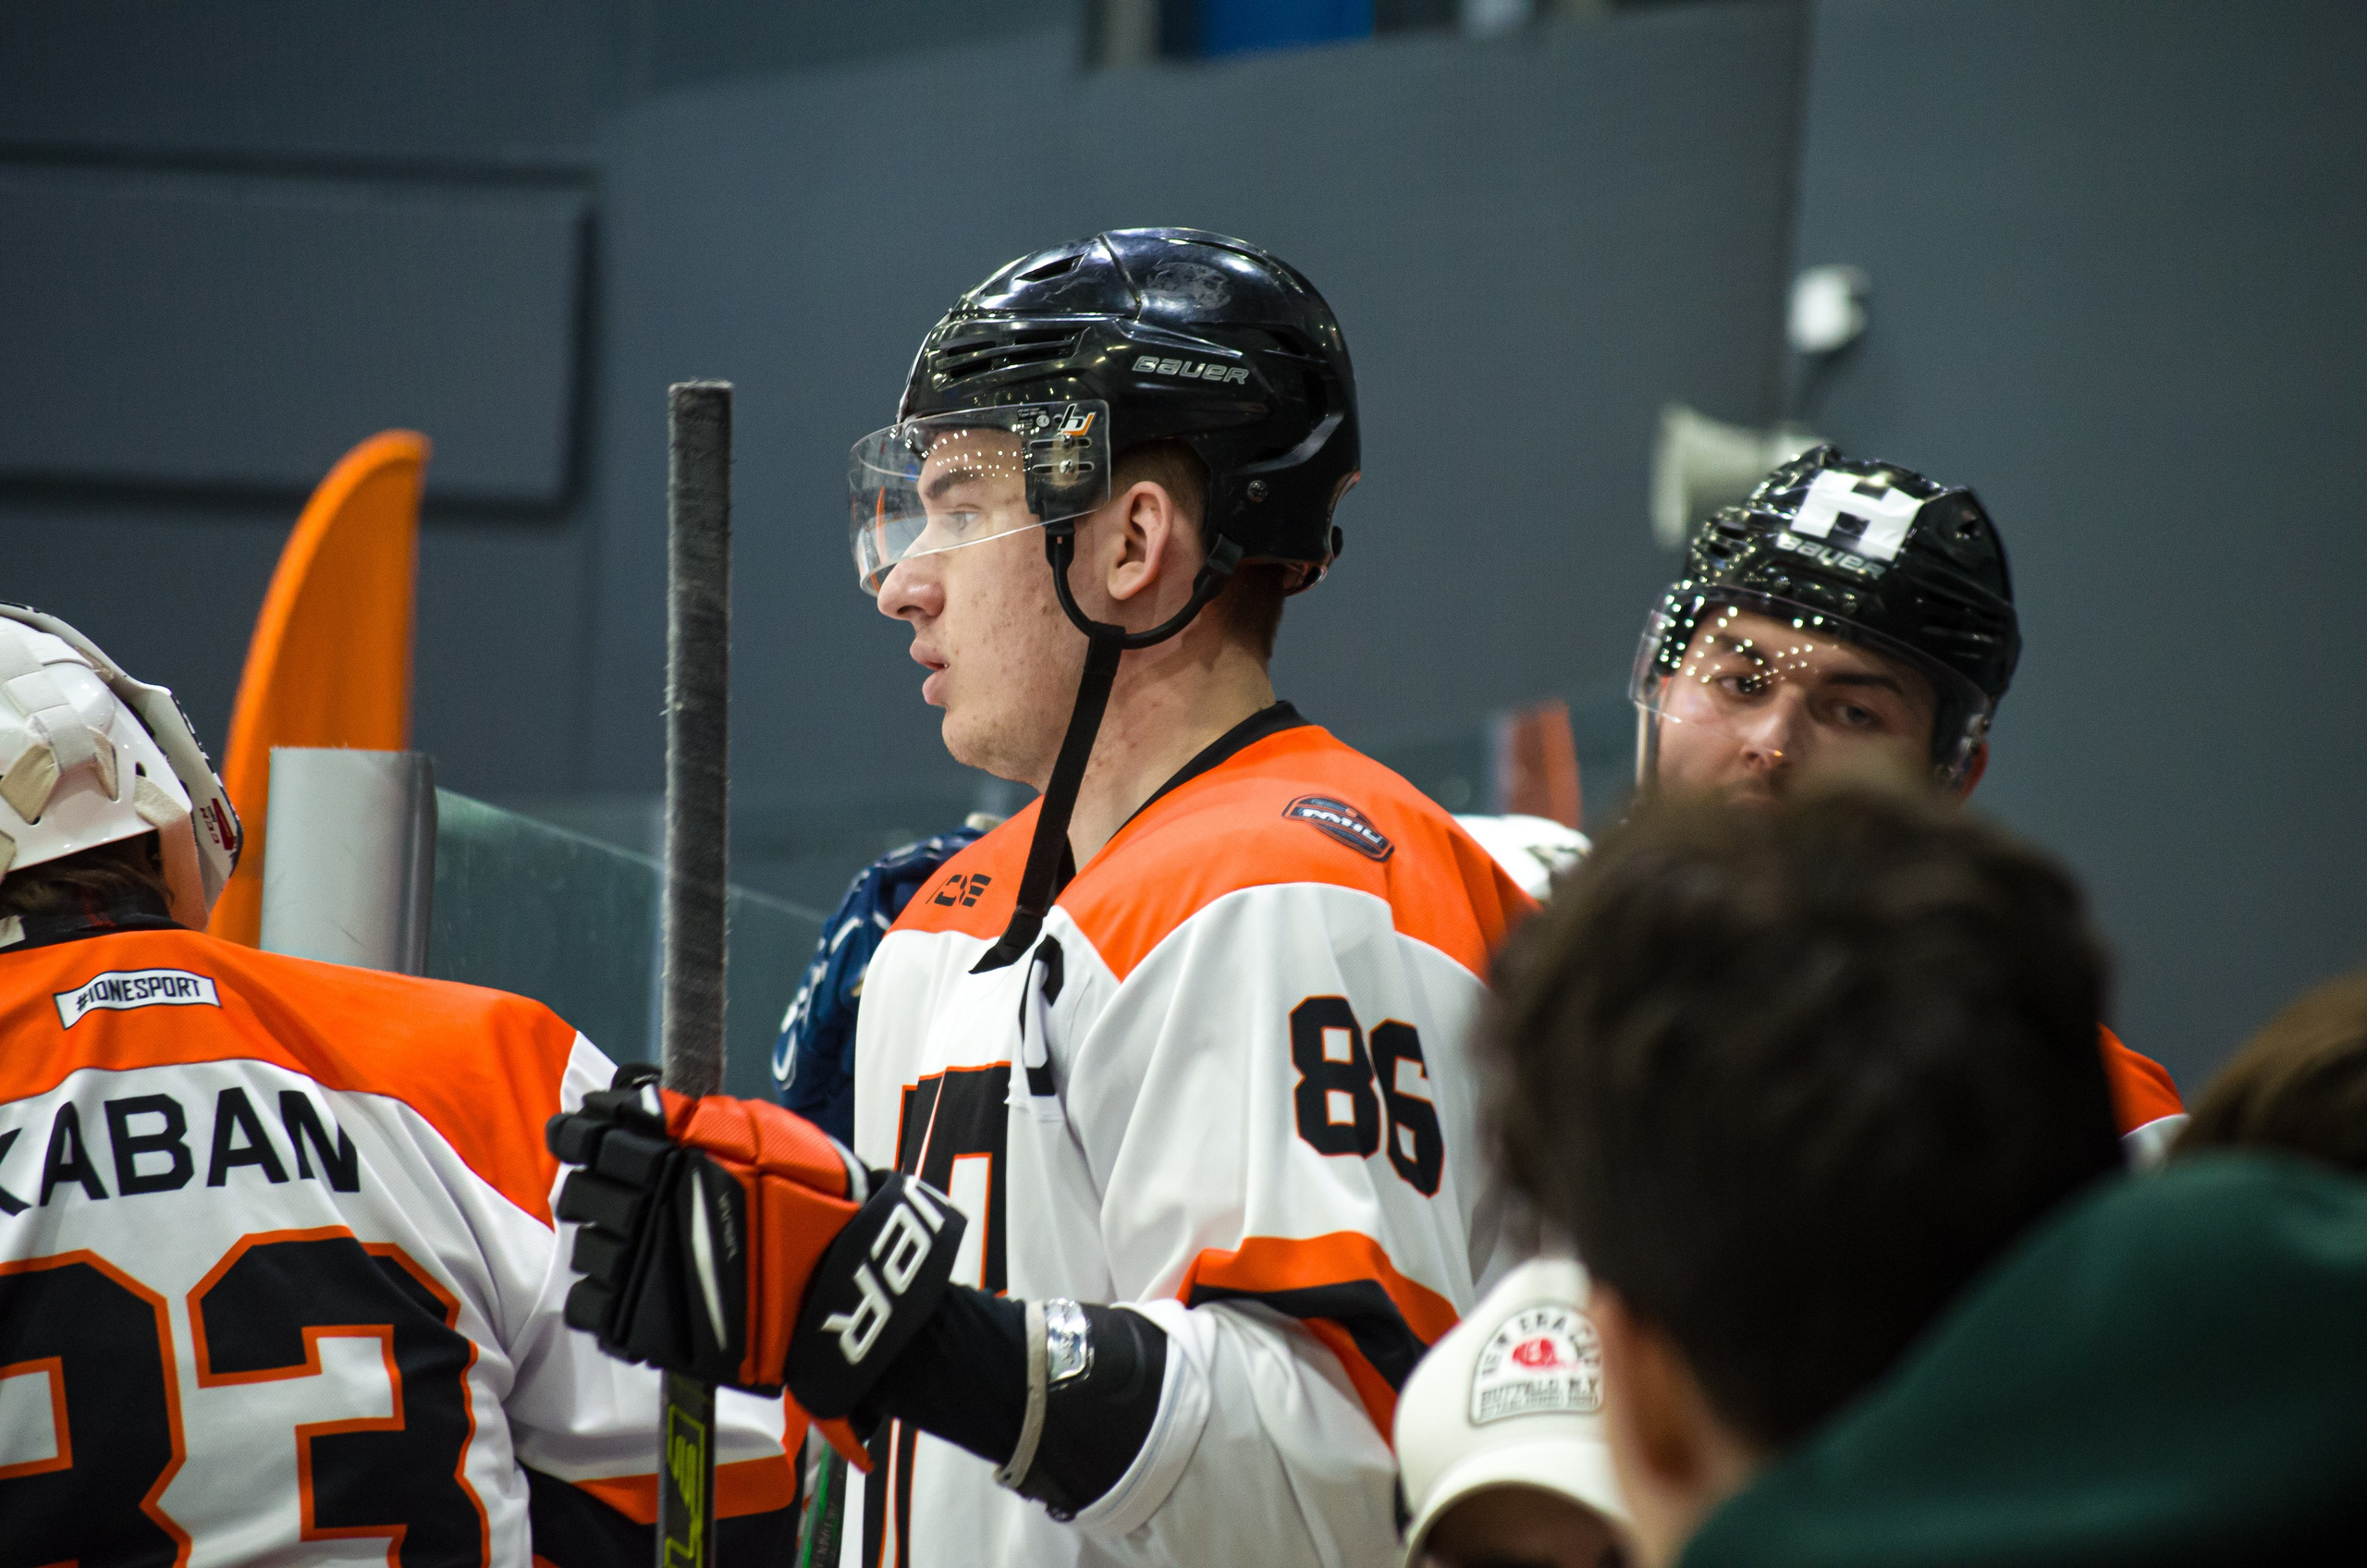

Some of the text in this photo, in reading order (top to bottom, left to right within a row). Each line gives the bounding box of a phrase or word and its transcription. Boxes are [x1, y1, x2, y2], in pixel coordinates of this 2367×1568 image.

[1132, 355, 1249, 385] BAUER
[1776, 533, 1887, 581] BAUER
[1289, 994, 1445, 1199] 86
